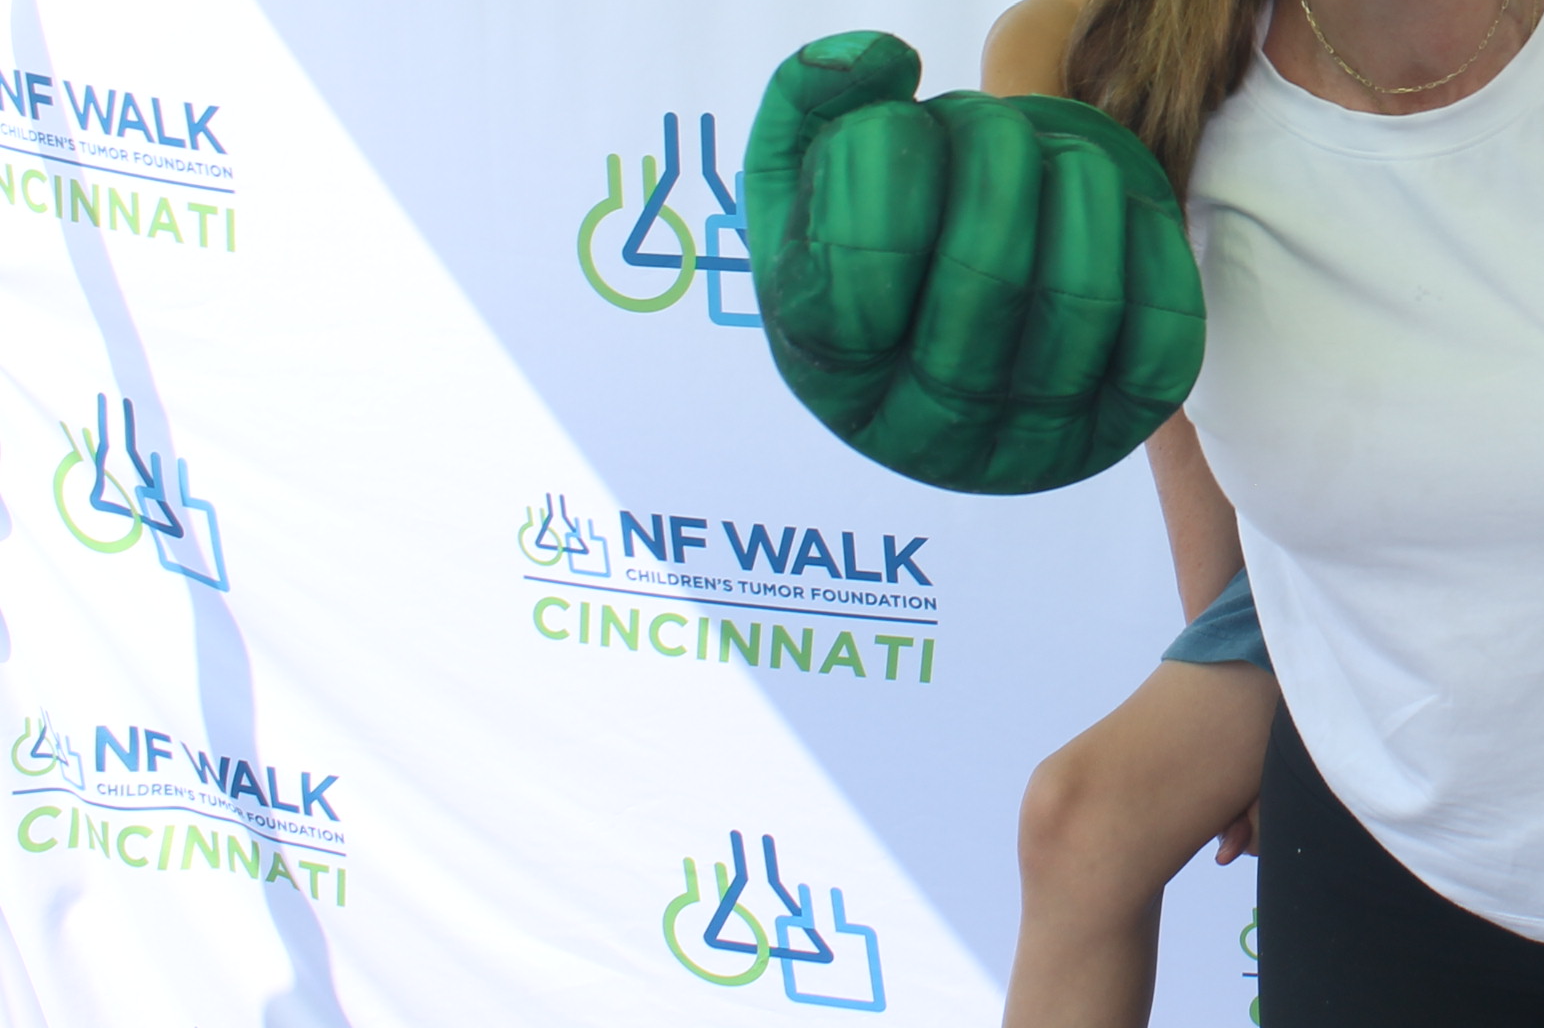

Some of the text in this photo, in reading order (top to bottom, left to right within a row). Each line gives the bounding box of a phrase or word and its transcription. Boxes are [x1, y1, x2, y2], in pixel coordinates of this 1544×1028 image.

[0, 69, 228, 156] NF WALK
[1, 124, 234, 180] CHILDREN'S TUMOR FOUNDATION
[619, 509, 933, 587] NF WALK
[625, 568, 938, 611] CHILDREN'S TUMOR FOUNDATION
[533, 596, 935, 684] CINCINNATI
[95, 725, 341, 822] NF WALK
[96, 783, 345, 844] CHILDREN'S TUMOR FOUNDATION
[17, 805, 346, 907] CINCINNATI
